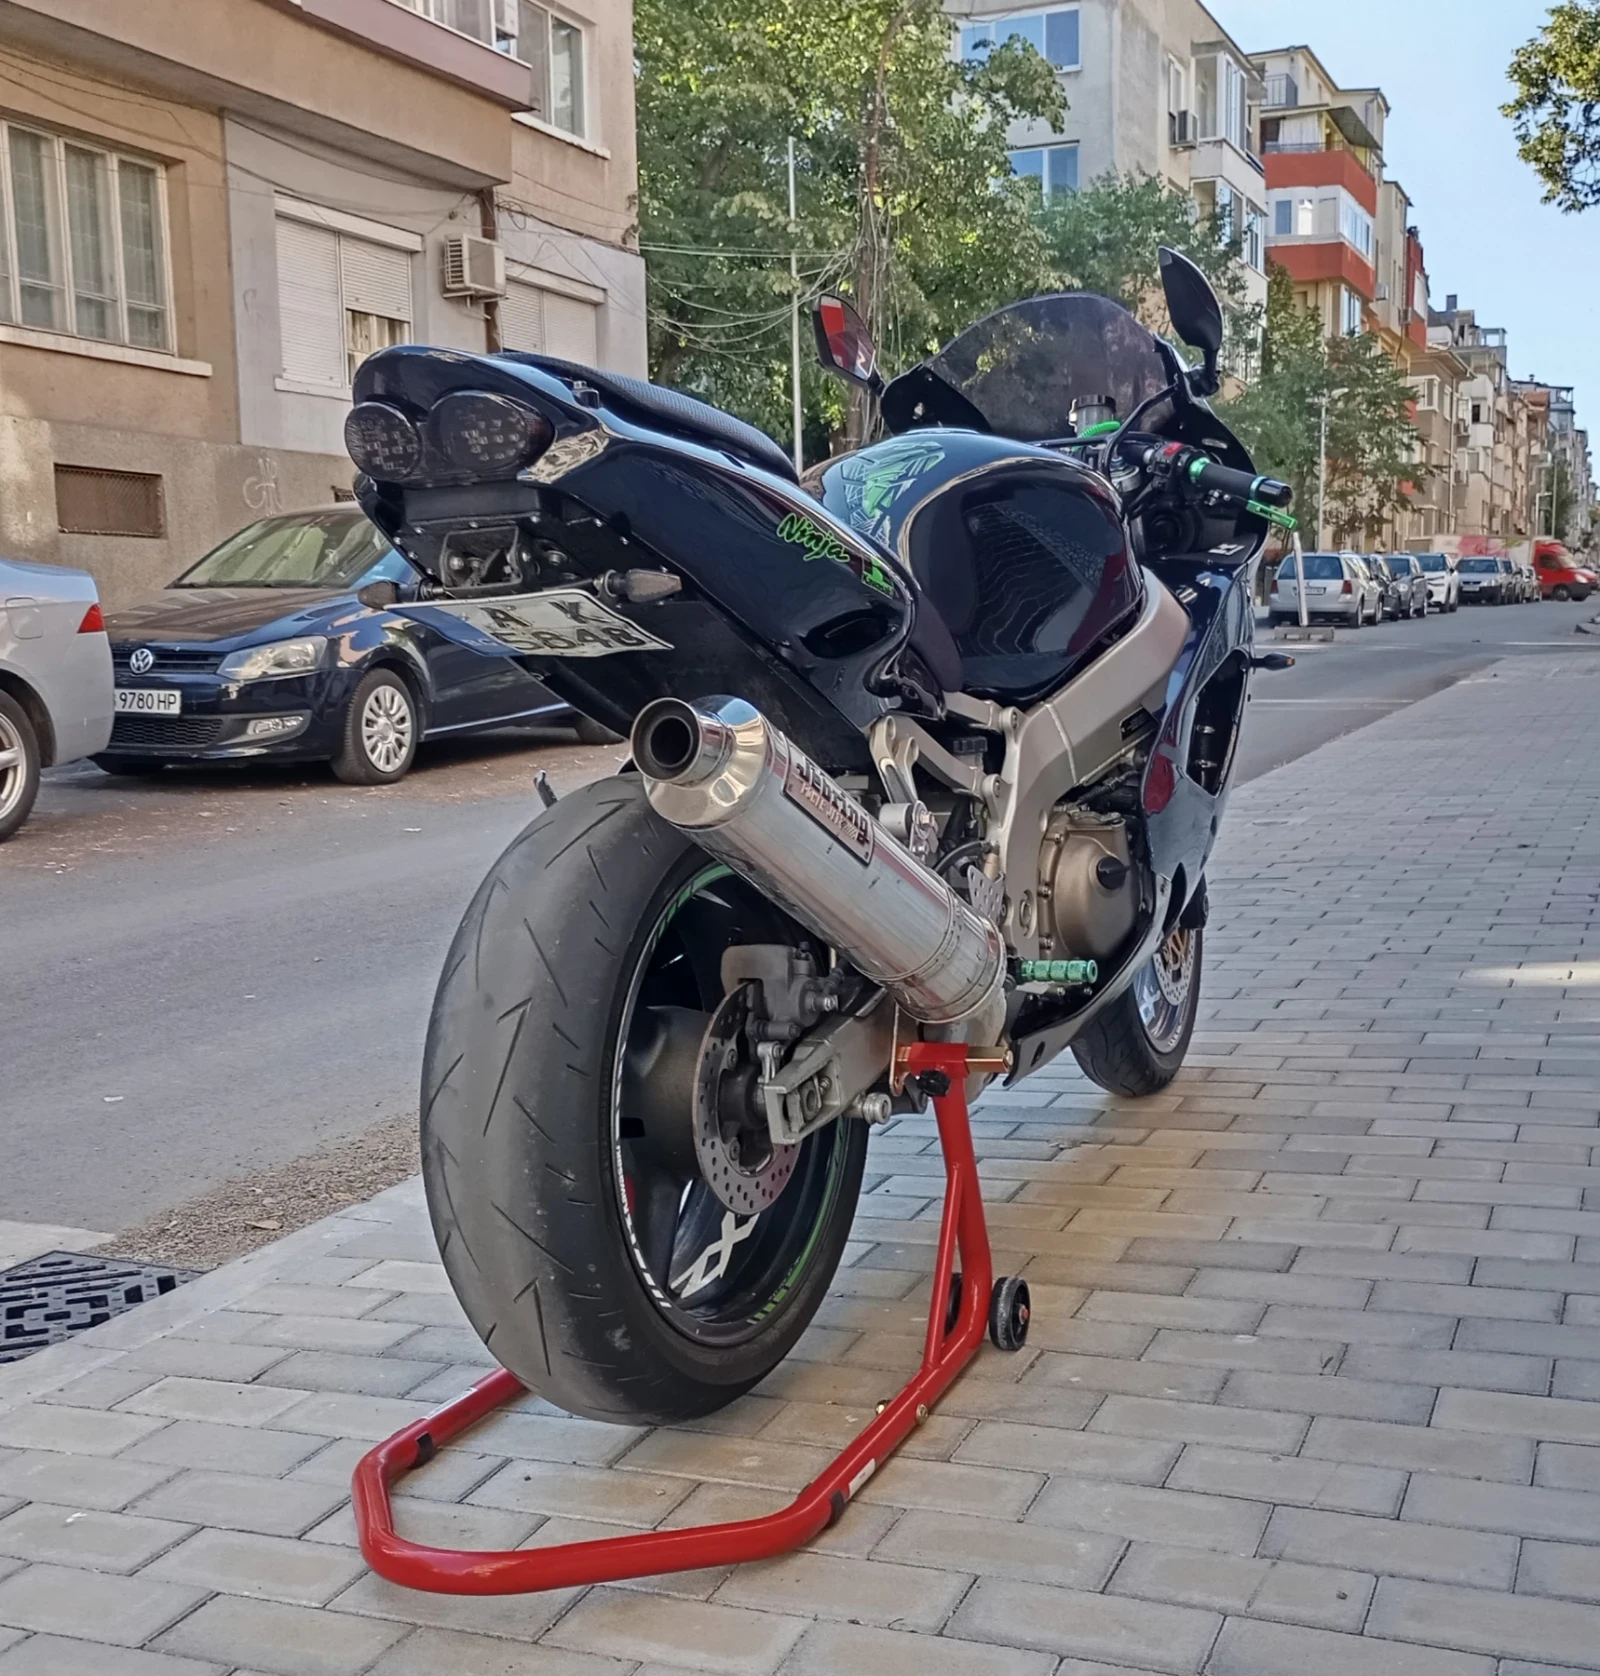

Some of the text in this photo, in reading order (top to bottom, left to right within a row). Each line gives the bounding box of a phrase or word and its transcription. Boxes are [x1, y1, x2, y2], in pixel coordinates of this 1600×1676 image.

[777, 514, 851, 562] Ninja
[479, 606, 532, 628] A
[119, 692, 155, 710] 9780
[157, 693, 177, 711] HP
